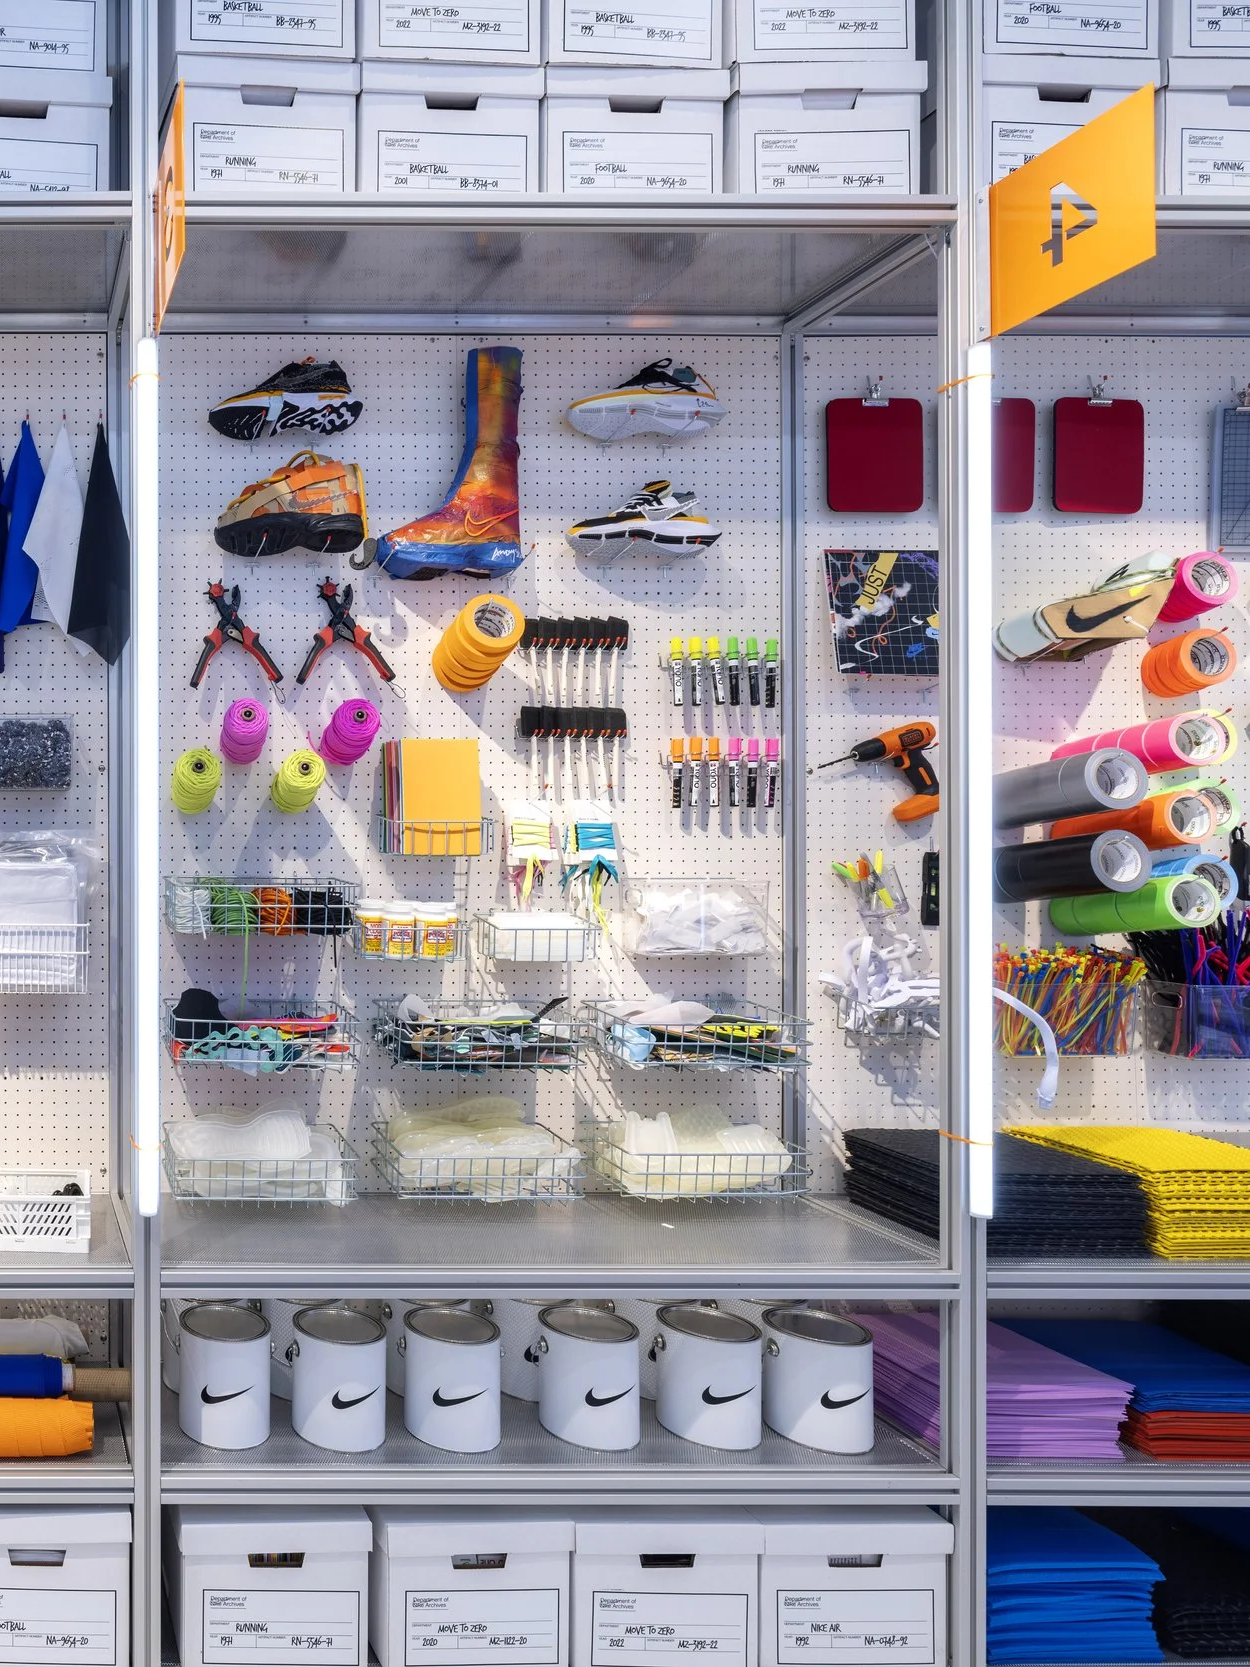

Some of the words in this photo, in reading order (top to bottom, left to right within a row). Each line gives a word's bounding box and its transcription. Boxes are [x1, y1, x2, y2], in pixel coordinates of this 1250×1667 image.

[223, 1, 263, 12] BASKETBALL
[1029, 4, 1061, 14] FOOTBALL
[410, 8, 430, 18] MOVE
[431, 8, 442, 17] TO
[442, 9, 460, 18] ZERO
[595, 12, 635, 24] BASKETBALL
[786, 9, 806, 19] MOVE
[807, 9, 818, 18] TO
[818, 9, 835, 18] ZERO
[207, 14, 221, 25] 1995
[395, 19, 411, 29] 2022
[1013, 16, 1029, 25] 2020
[1207, 19, 1222, 31] 1995
[580, 25, 594, 36] 1995
[771, 23, 786, 32] 2022
[225, 156, 256, 168] RUNNING
[1213, 161, 1245, 172] RUNNING
[210, 168, 223, 179] 1971
[409, 163, 449, 175] BASKETBALL
[595, 163, 627, 173] FOOTBALL
[787, 163, 820, 174] RUNNING
[394, 176, 408, 186] 2001
[580, 176, 595, 185] 2020
[772, 177, 785, 188] 1971
[1198, 173, 1210, 184] 1971
[1040, 181, 1097, 267] 4
[861, 564, 888, 605] JUST
[235, 1622, 268, 1633] RUNNING
[437, 1624, 458, 1634] MOVE
[459, 1623, 469, 1633] TO
[470, 1623, 487, 1633] ZERO
[624, 1625, 645, 1636] MOVE
[646, 1625, 656, 1635] TO
[657, 1626, 675, 1635] ZERO
[810, 1623, 828, 1633] NIKE
[829, 1623, 842, 1633] AIR
[220, 1636, 233, 1646] 1971
[422, 1637, 438, 1647] 2020
[609, 1638, 625, 1648] 2022
[795, 1636, 810, 1646] 1992
